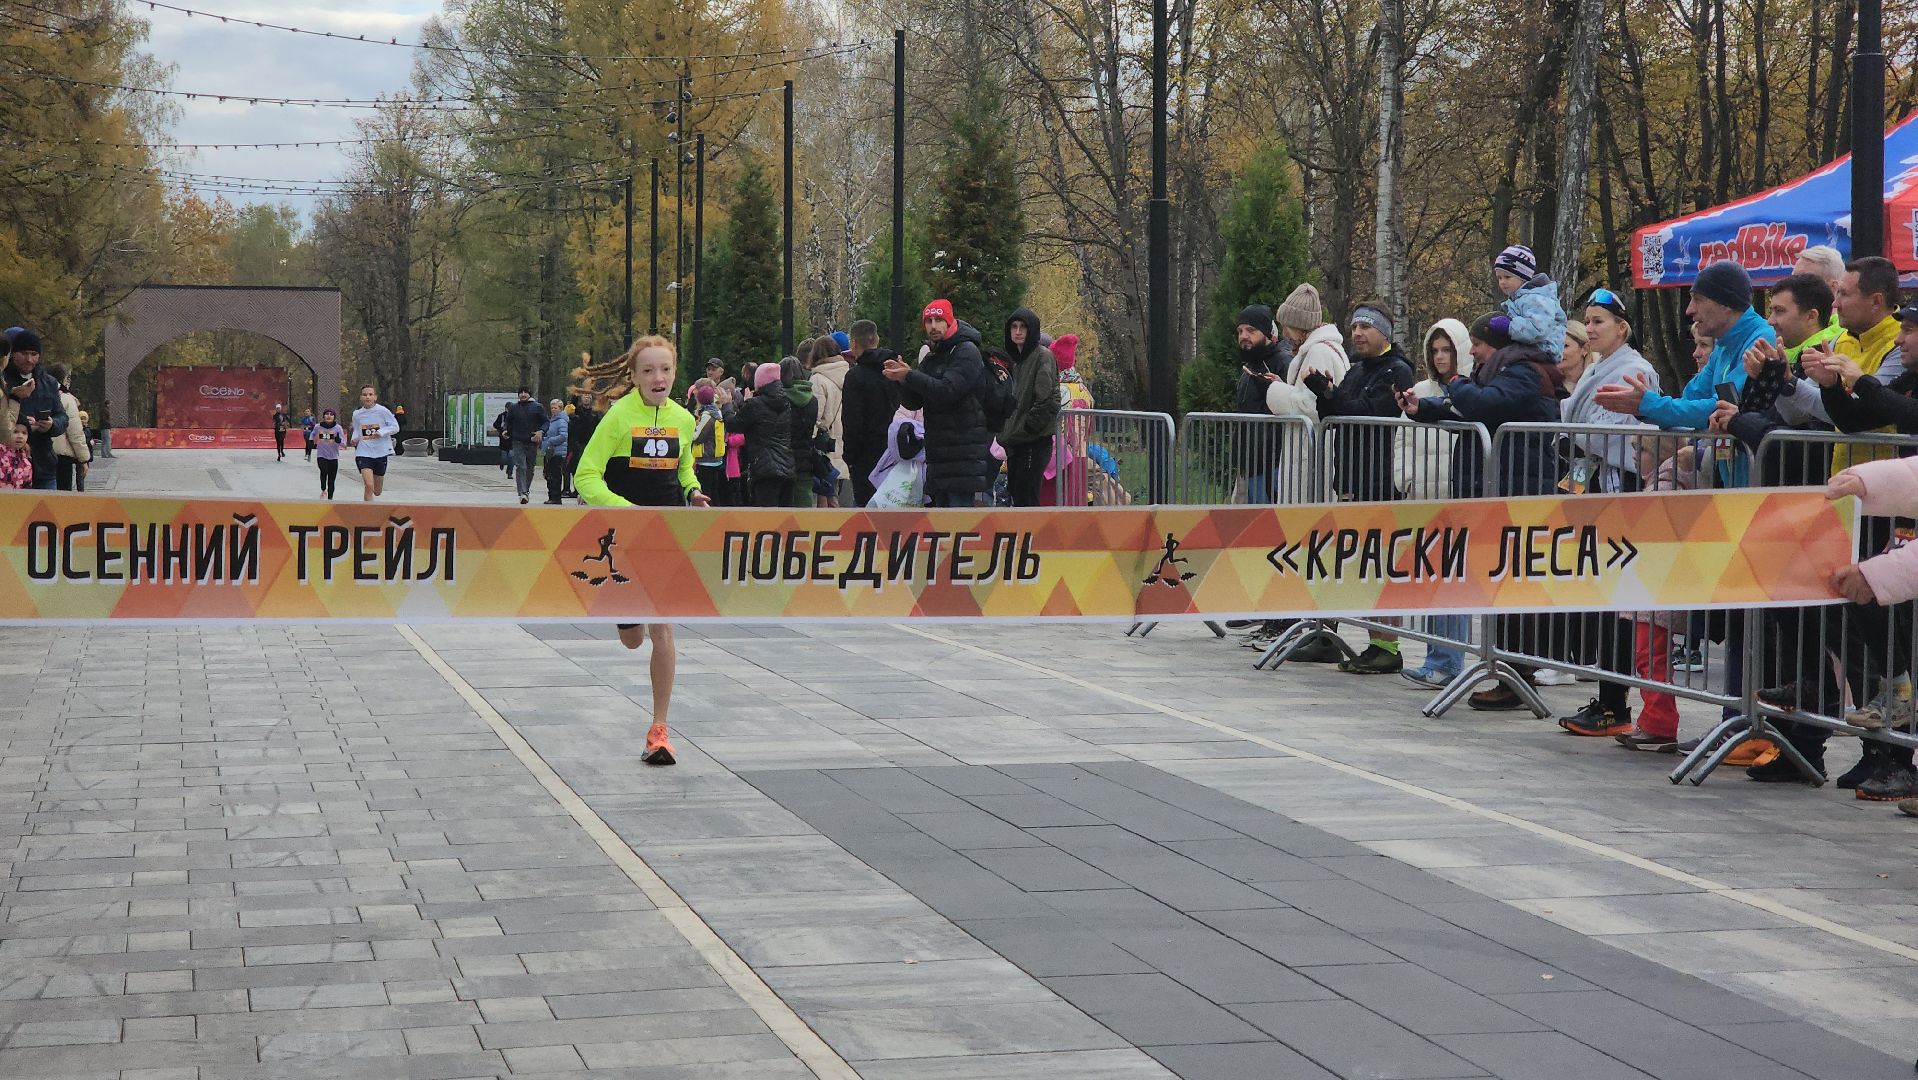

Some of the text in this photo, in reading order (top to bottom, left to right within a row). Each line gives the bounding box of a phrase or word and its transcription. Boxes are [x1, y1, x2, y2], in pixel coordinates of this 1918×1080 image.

[1698, 222, 1808, 271] redBike
[643, 438, 669, 457] 49
[26, 512, 456, 584] ОСЕННИЙ ТРЕЙЛ
[720, 529, 1041, 589] ПОБЕДИТЕЛЬ
[1265, 523, 1638, 582] «КРАСКИ ЛЕСА»
